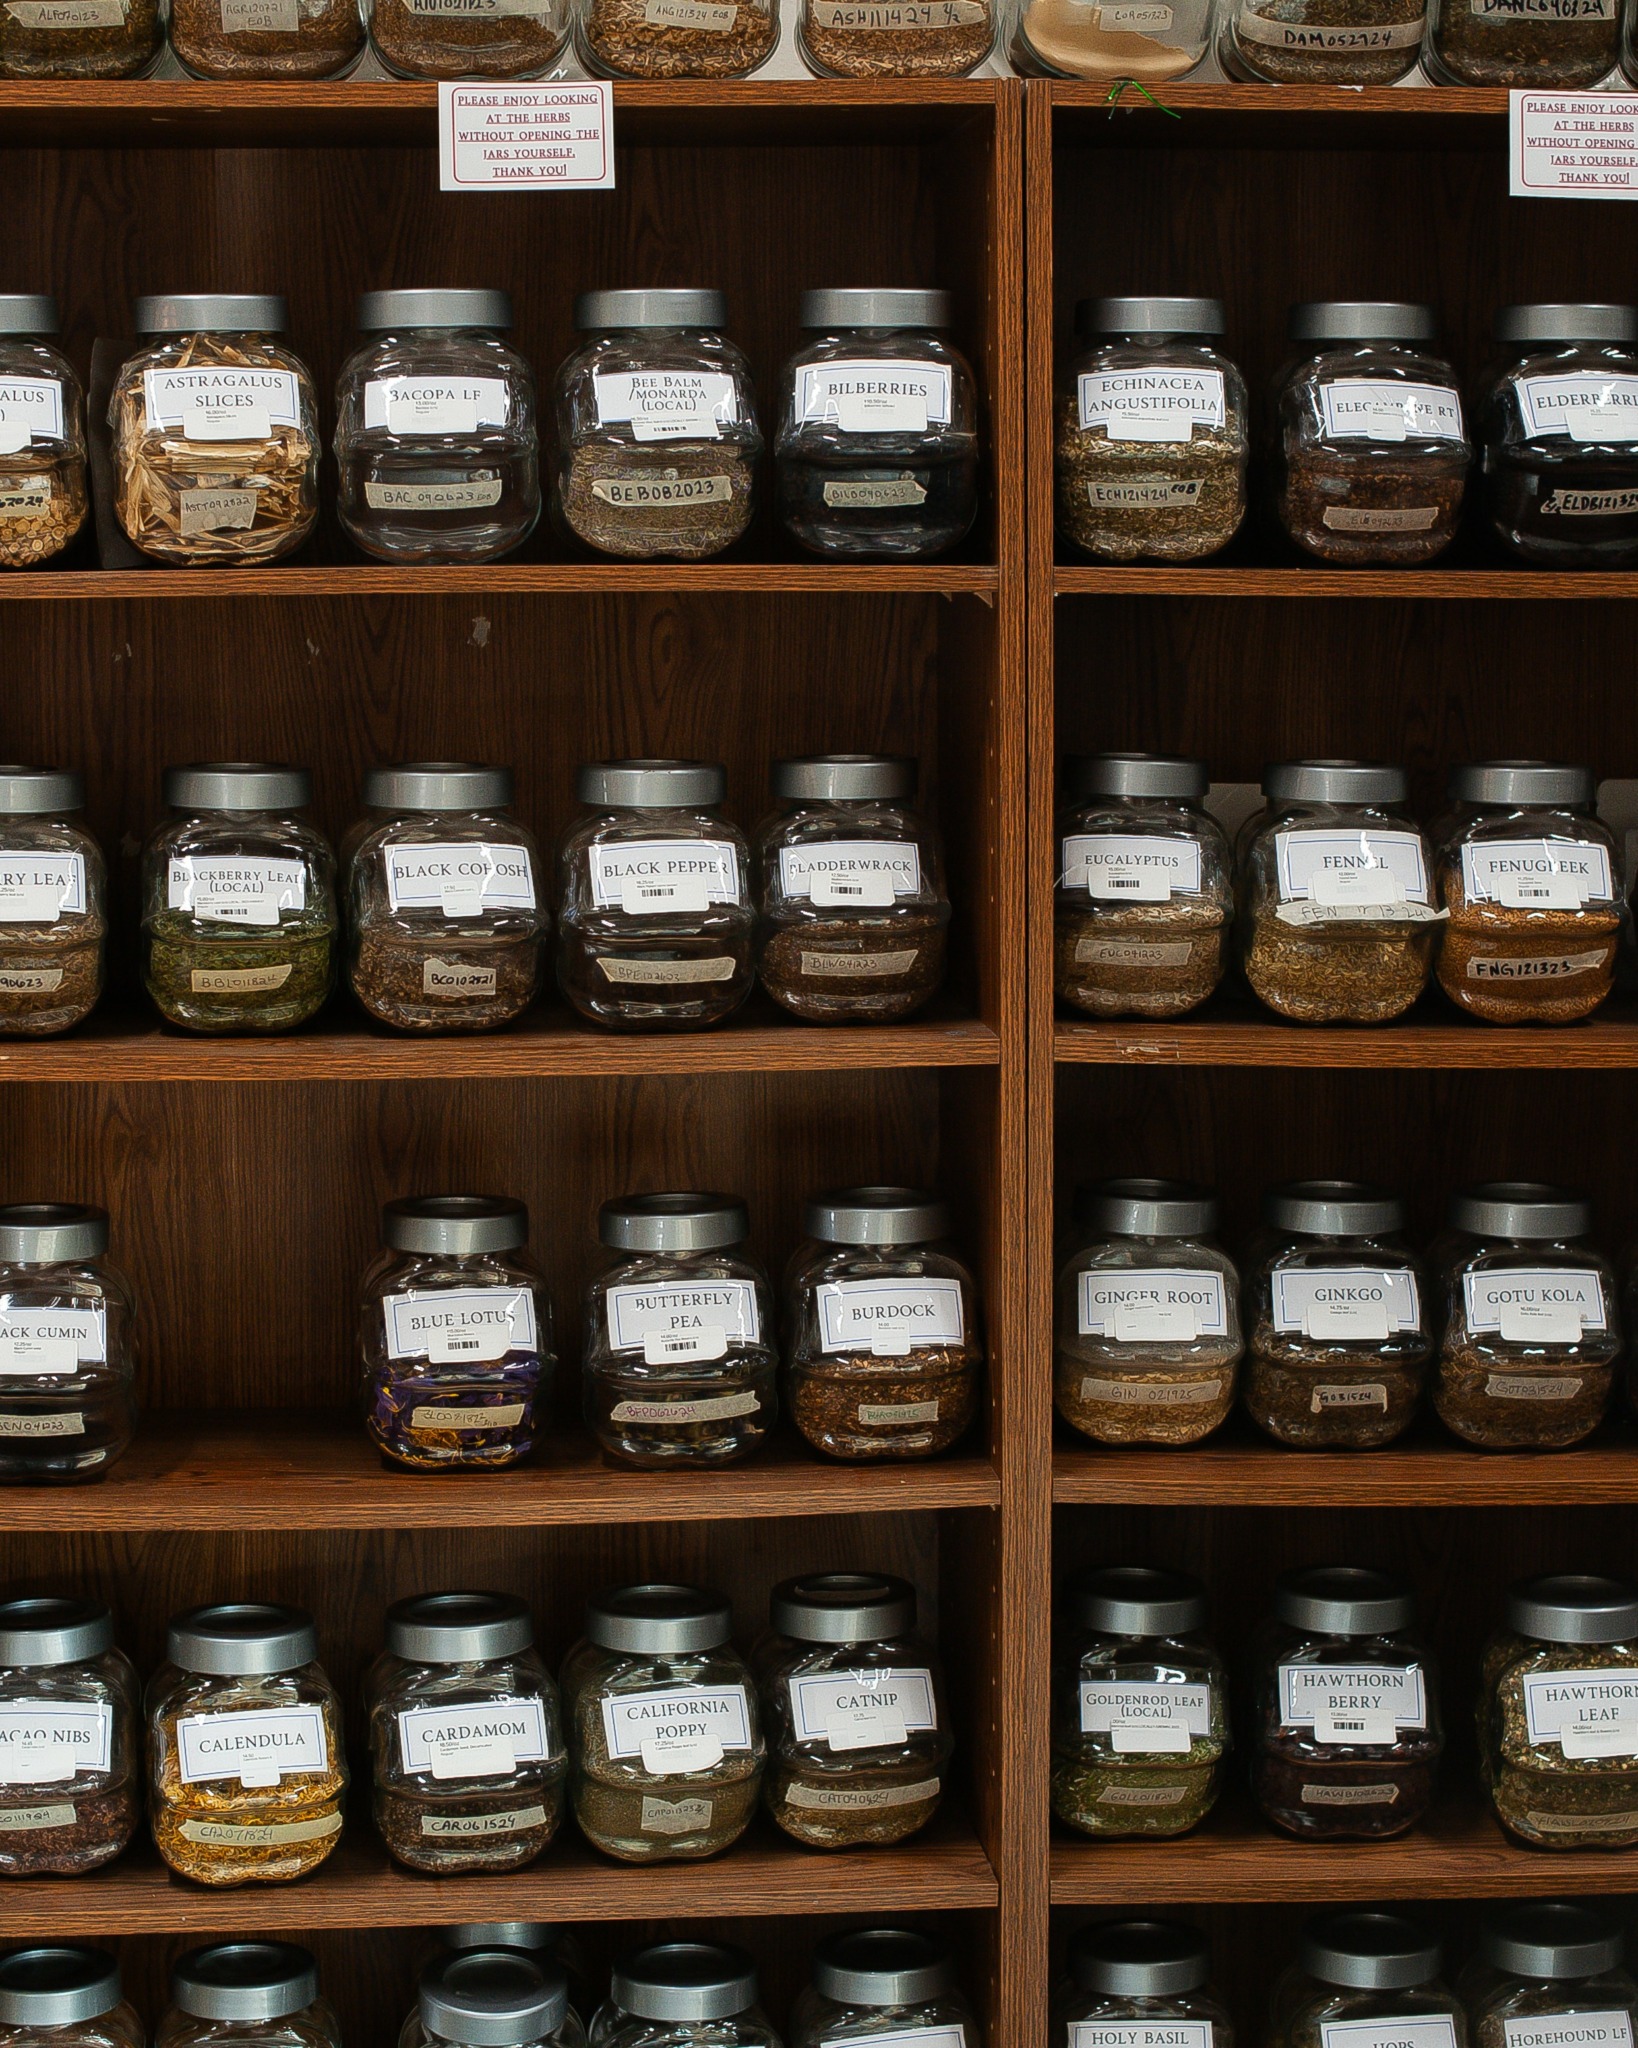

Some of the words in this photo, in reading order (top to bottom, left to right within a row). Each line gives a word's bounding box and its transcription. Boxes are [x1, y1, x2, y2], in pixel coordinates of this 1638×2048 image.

[457, 94, 496, 106] PLEASE
[503, 94, 540, 106] ENJOY
[544, 93, 598, 105] LOOKING
[1527, 102, 1566, 114] PLEASE
[1571, 103, 1609, 115] ENJOY
[486, 113, 501, 124] AT
[506, 113, 529, 124] THE
[534, 112, 571, 123] HERBS
[1554, 121, 1569, 131] AT
[1573, 121, 1595, 131] THE
[1599, 121, 1634, 132] HERBS
[458, 130, 514, 142] WITHOUT
[519, 130, 572, 141] OPENING
[577, 129, 599, 140] THE
[1527, 137, 1581, 148] WITHOUT
[1584, 138, 1635, 149] OPENING
[483, 148, 509, 159] JARS
[514, 148, 575, 159] YOURSELF,
[1550, 155, 1575, 165] JARS
[492, 166, 534, 177] THANK
[539, 165, 567, 177] YOU!
[1559, 172, 1599, 183] THANK
[1603, 172, 1630, 184] YOU!
[164, 375, 283, 389] ASTRAGALUS
[827, 381, 928, 397] BILBERRIES
[1102, 377, 1204, 393] ECHINACEA
[195, 394, 255, 408] SLICES
[389, 389, 455, 401] BACOPA
[463, 389, 481, 401] LF
[641, 398, 698, 412] (LOCAL)
[1088, 396, 1218, 413] ANGUSTIFOLIA
[1438, 405, 1455, 418] RT
[383, 490, 413, 503] BAC
[1096, 487, 1168, 501] ECH121424
[1085, 854, 1179, 868] EUCALYPTUS
[395, 862, 451, 880] BLACK
[603, 861, 661, 878] BLACK
[667, 860, 729, 876] PEPPER
[209, 880, 264, 895] (LOCAL)
[1301, 905, 1338, 919] FEN
[1380, 905, 1395, 918] 13
[1402, 906, 1426, 920] 24
[1476, 960, 1571, 977] FNG121323
[635, 1291, 733, 1311] BUTTERFLY
[1094, 1290, 1161, 1305] GINGER
[1167, 1290, 1213, 1305] ROOT
[1314, 1287, 1383, 1302] GINKGO
[1486, 1289, 1535, 1304] GOTU
[1541, 1288, 1586, 1302] KOLA
[411, 1313, 455, 1330] BLUE
[459, 1310, 515, 1325] LOTUS
[852, 1304, 936, 1321] BURDOCK
[670, 1314, 703, 1329] PEA
[37, 1327, 88, 1339] CUMIN
[1111, 1386, 1138, 1400] GIN
[1303, 1674, 1405, 1688] HAWTHORN
[836, 1692, 898, 1709] CATNIP
[1086, 1692, 1171, 1707] GOLDENROD
[1174, 1696, 1205, 1708] LEAF
[1328, 1695, 1382, 1709] BERRY
[626, 1698, 730, 1720] CALIFORNIA
[1120, 1704, 1172, 1719] (LOCAL)
[1579, 1707, 1620, 1722] LEAF
[52, 1729, 91, 1744] NIBS
[421, 1721, 527, 1744] CARDAMOM
[655, 1722, 708, 1740] POPPY
[199, 1732, 306, 1754] CALENDULA
[1092, 2031, 1138, 2046] HOLY
[1143, 2030, 1190, 2046] BASIL
[1509, 2028, 1607, 2048] HOREHOUND
[1612, 2027, 1628, 2040] LF
